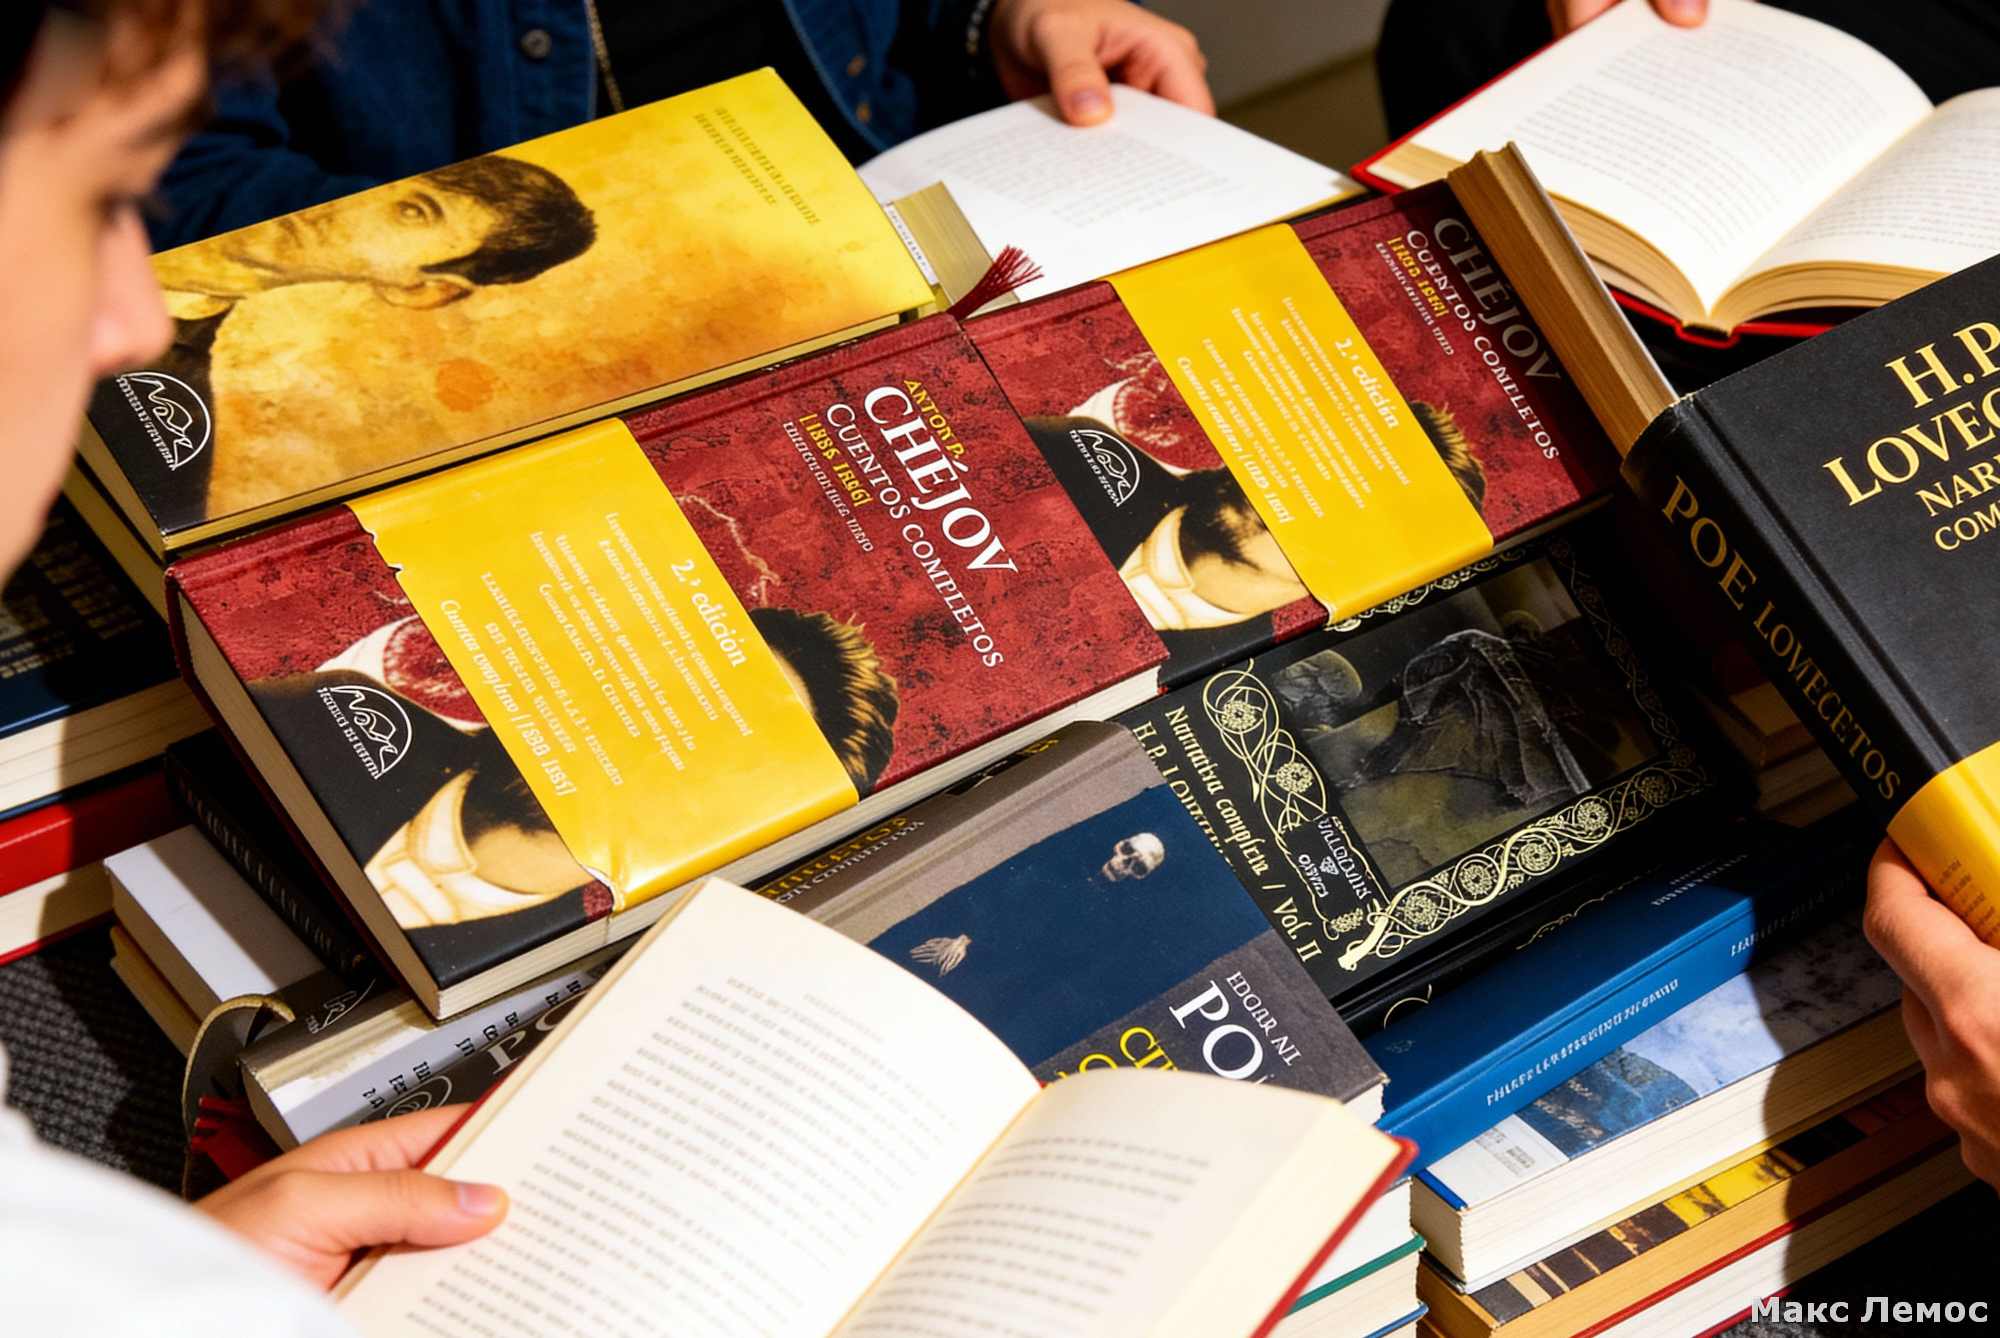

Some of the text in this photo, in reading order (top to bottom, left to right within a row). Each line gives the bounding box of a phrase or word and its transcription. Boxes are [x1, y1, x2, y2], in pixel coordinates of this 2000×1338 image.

[827, 404, 1004, 668] CUENTOS COMPLETOS
[864, 386, 1018, 573] CHÉJOV
[1662, 475, 1757, 611] POE
[691, 590, 748, 669] edición
[1273, 897, 1312, 940] Vol.
[1297, 939, 1322, 962] II
